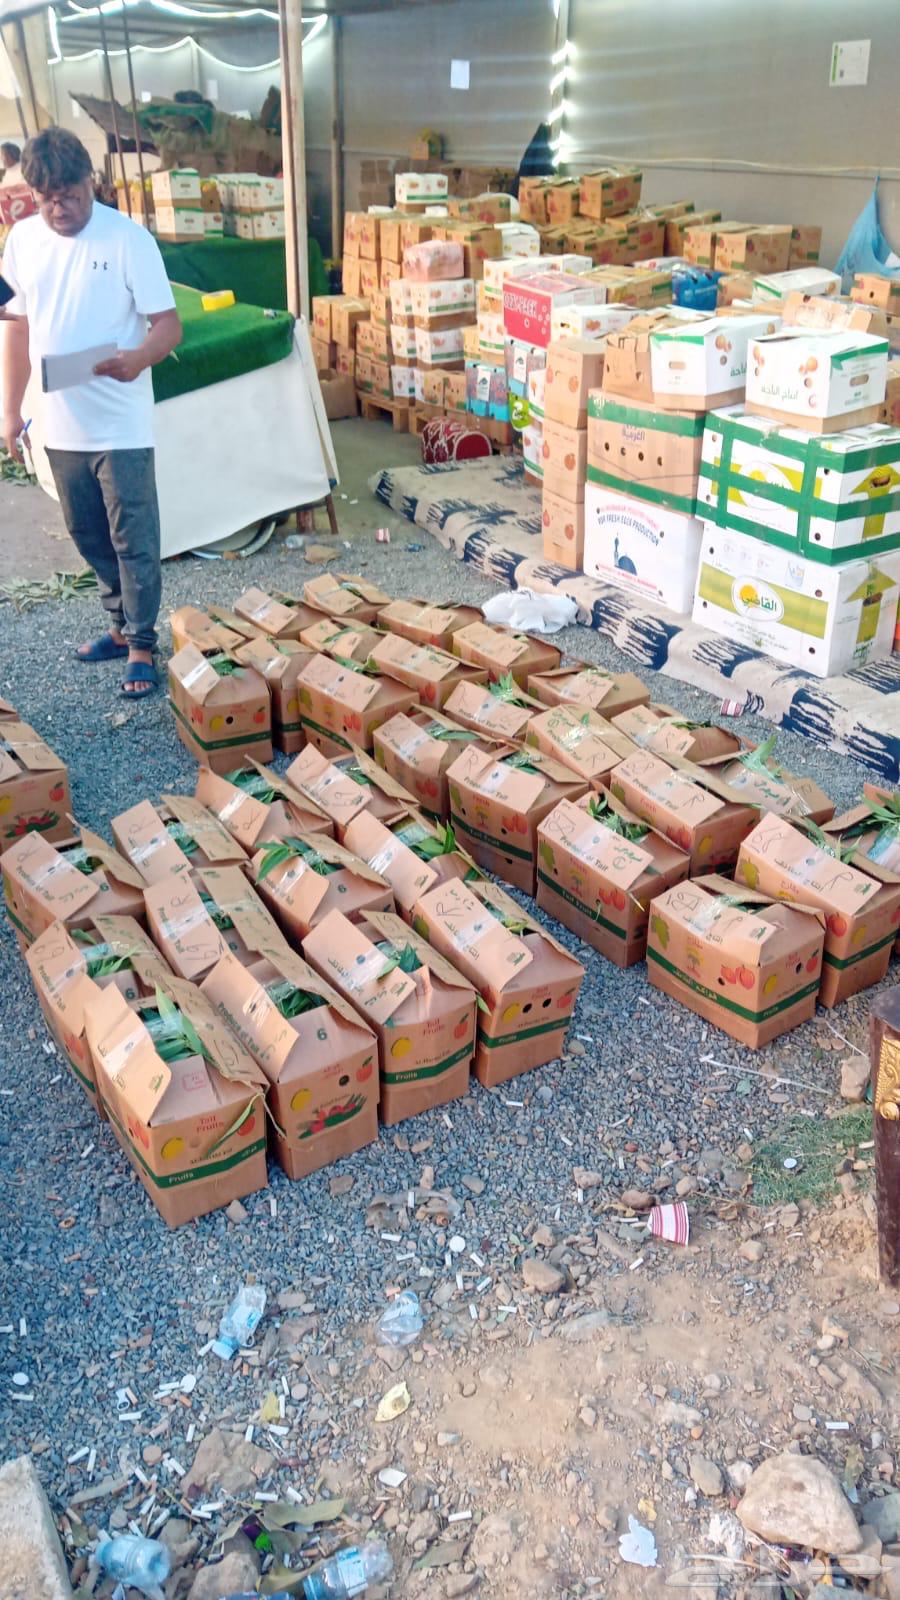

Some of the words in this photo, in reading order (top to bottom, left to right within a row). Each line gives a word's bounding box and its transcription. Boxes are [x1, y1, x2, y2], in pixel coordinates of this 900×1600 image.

[606, 513, 621, 523] FRESH
[632, 520, 659, 547] PRODUCTION
[317, 1028, 328, 1041] 6
[168, 1171, 194, 1184] Fruits
